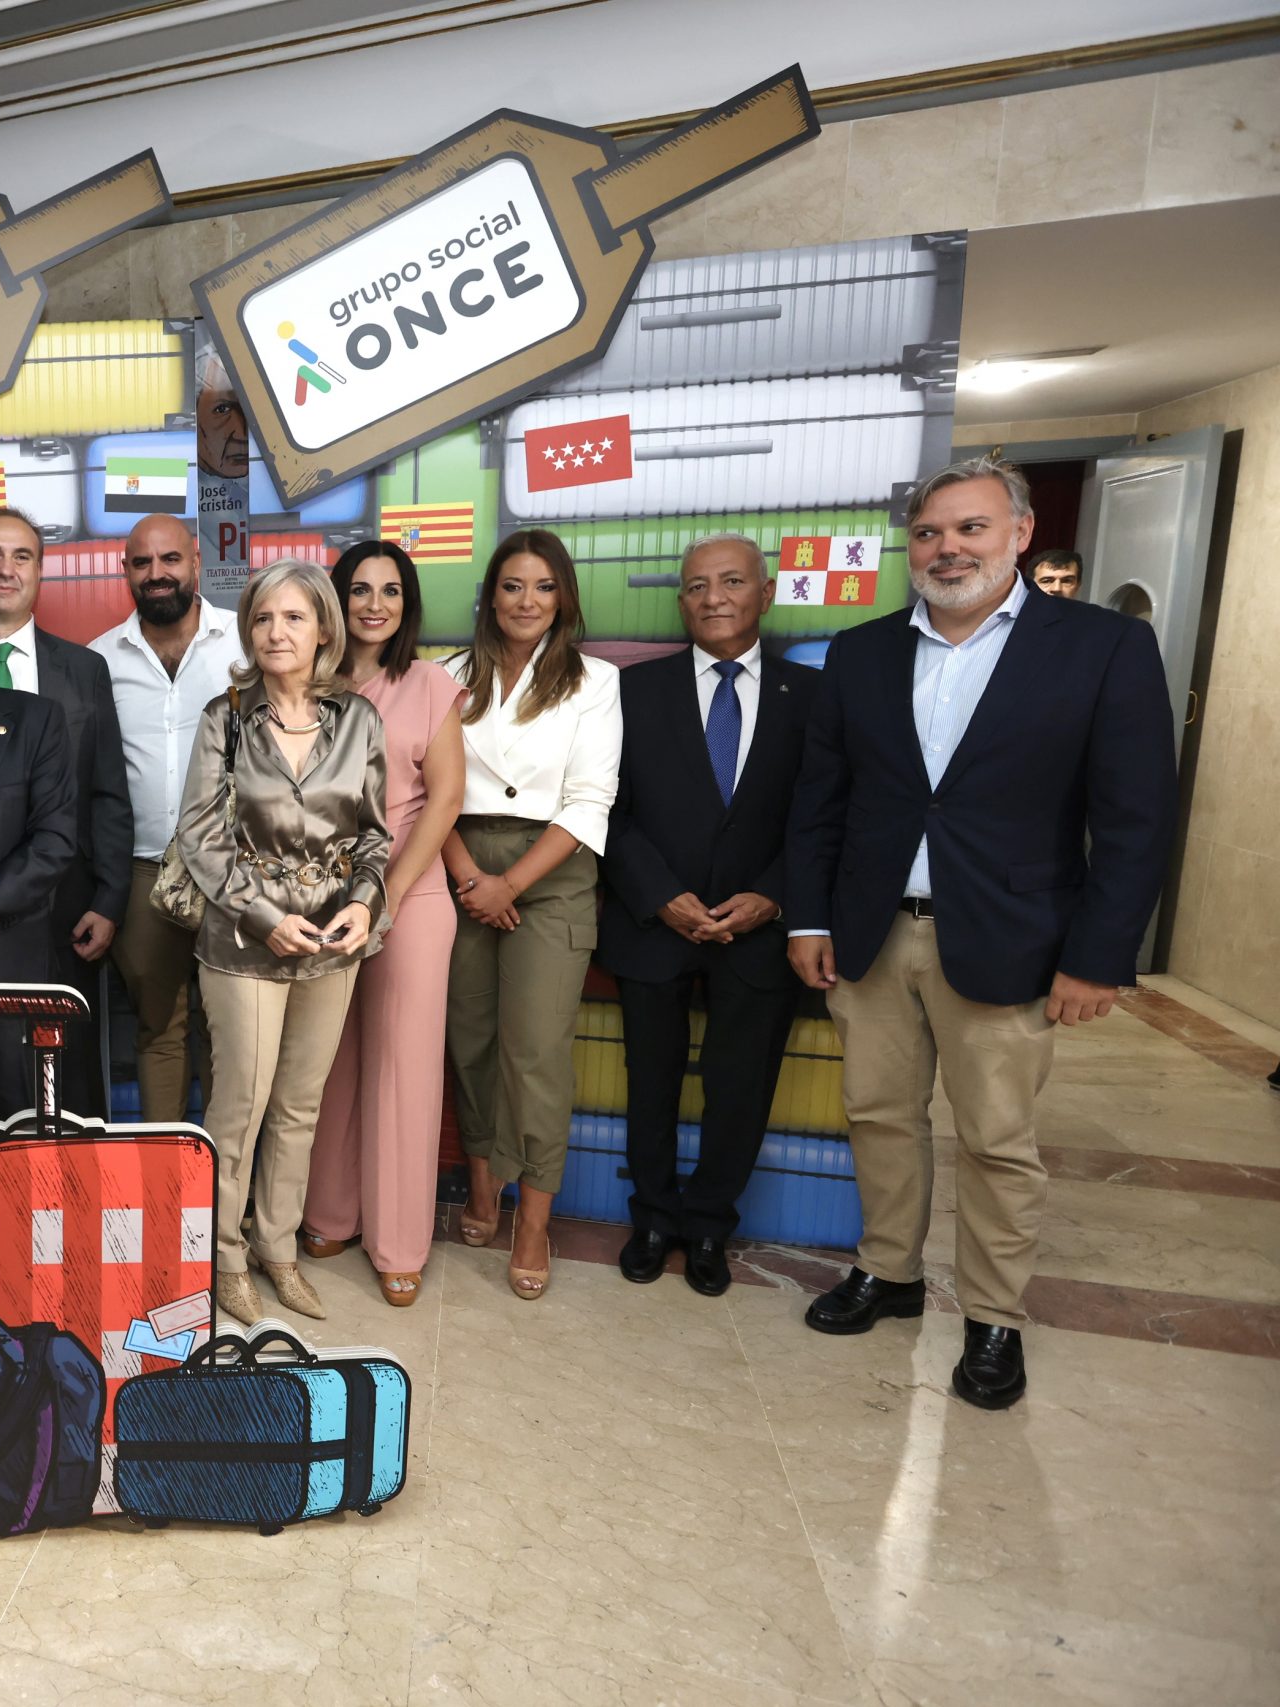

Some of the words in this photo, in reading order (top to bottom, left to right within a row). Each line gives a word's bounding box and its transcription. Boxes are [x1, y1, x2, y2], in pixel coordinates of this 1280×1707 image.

[329, 261, 421, 327] grupo
[428, 200, 521, 269] social
[345, 241, 544, 370] ONCE
[200, 484, 227, 501] José
[219, 521, 247, 561] Pi
[206, 568, 230, 577] TEATRO
